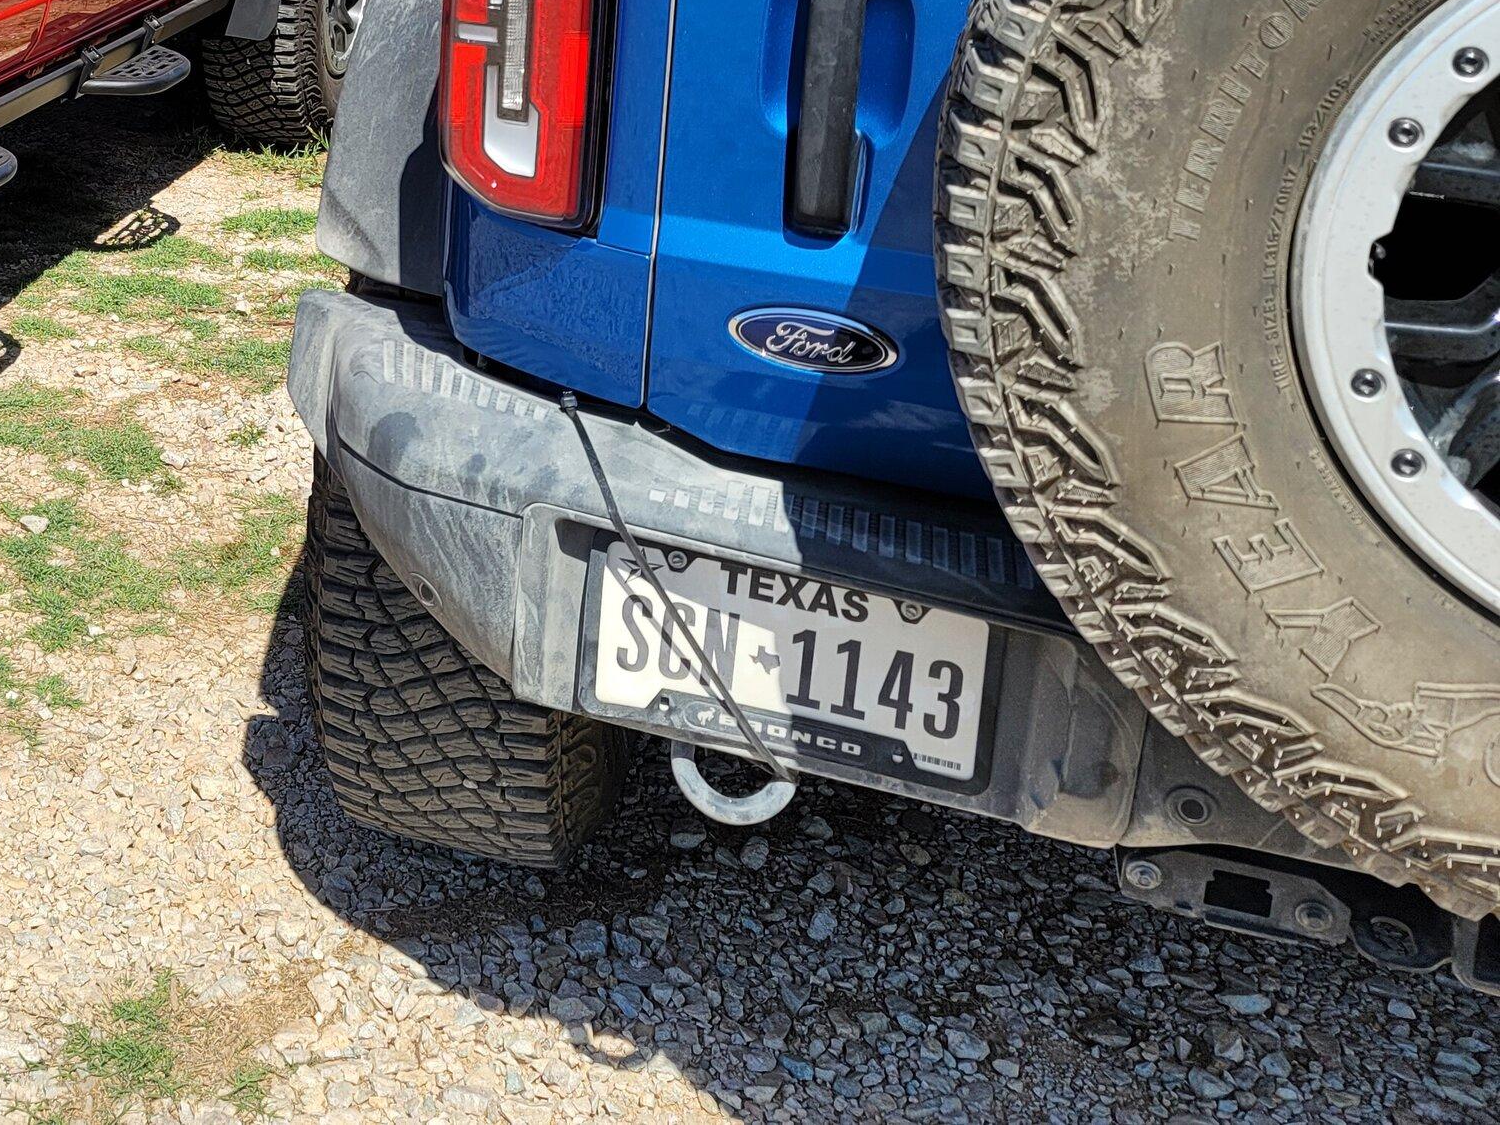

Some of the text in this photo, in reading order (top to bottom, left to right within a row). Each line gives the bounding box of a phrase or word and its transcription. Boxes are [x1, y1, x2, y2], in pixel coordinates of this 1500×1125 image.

[765, 320, 856, 365] Ford
[1143, 340, 1383, 678] YEAR
[719, 562, 870, 624] TEXAS
